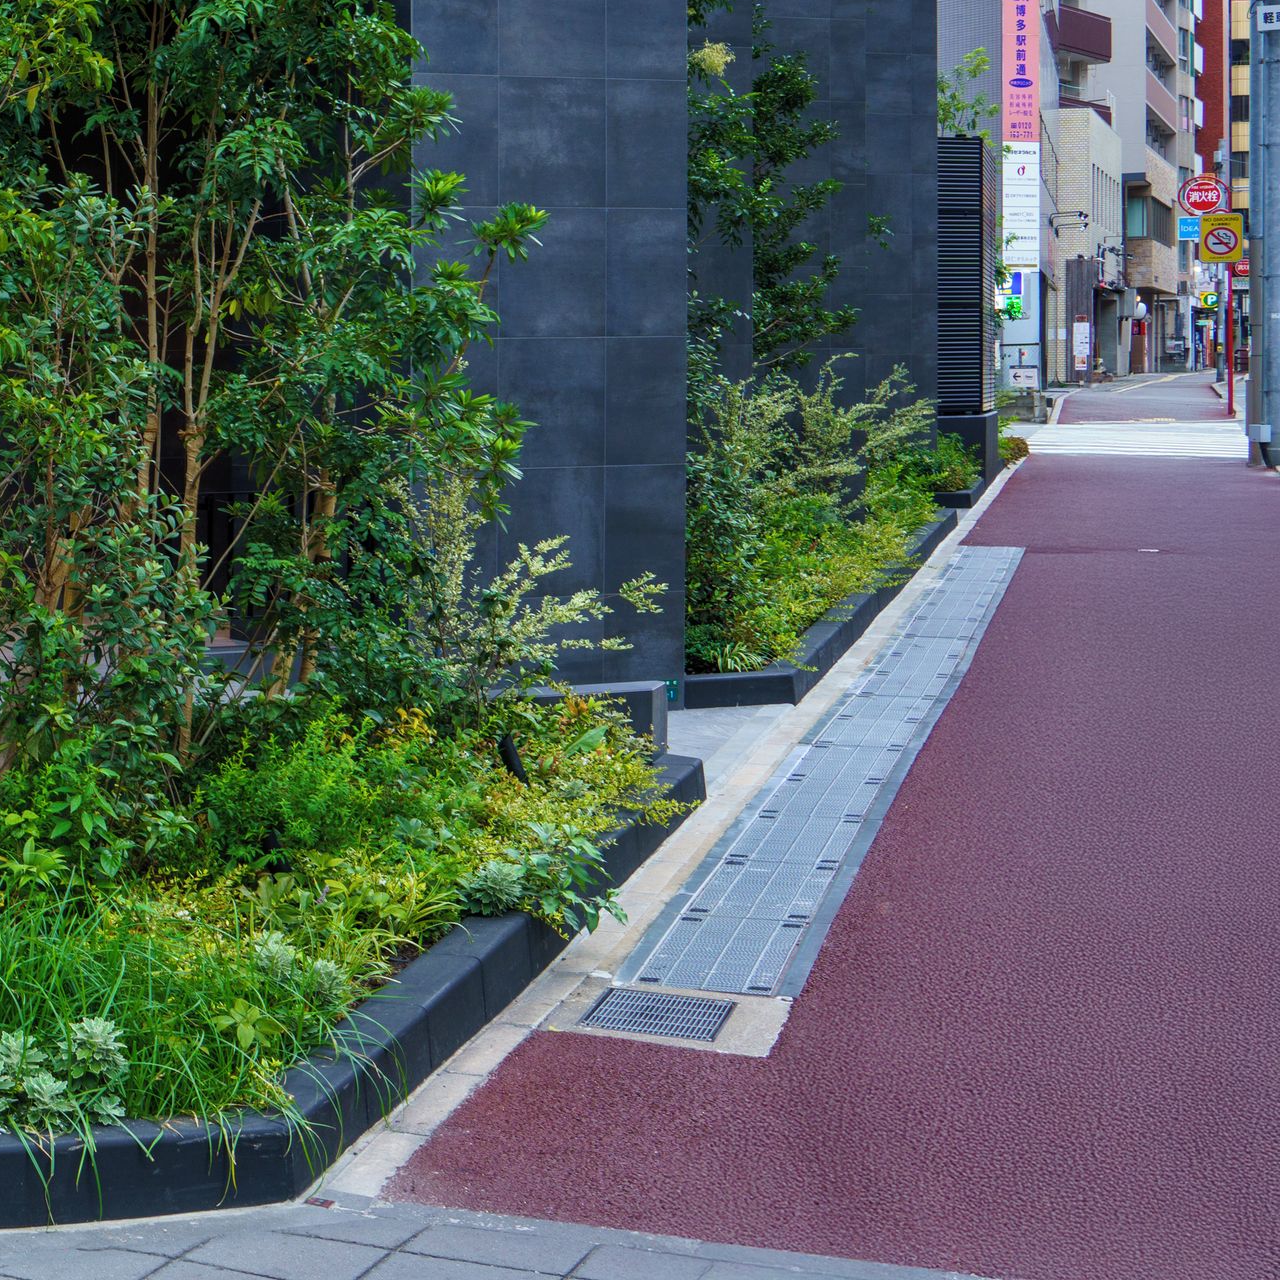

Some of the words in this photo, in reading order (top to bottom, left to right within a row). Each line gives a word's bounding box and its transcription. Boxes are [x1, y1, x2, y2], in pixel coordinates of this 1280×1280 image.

[1016, 5, 1027, 76] 博多駅前通
[1189, 191, 1218, 203] 消火栓
